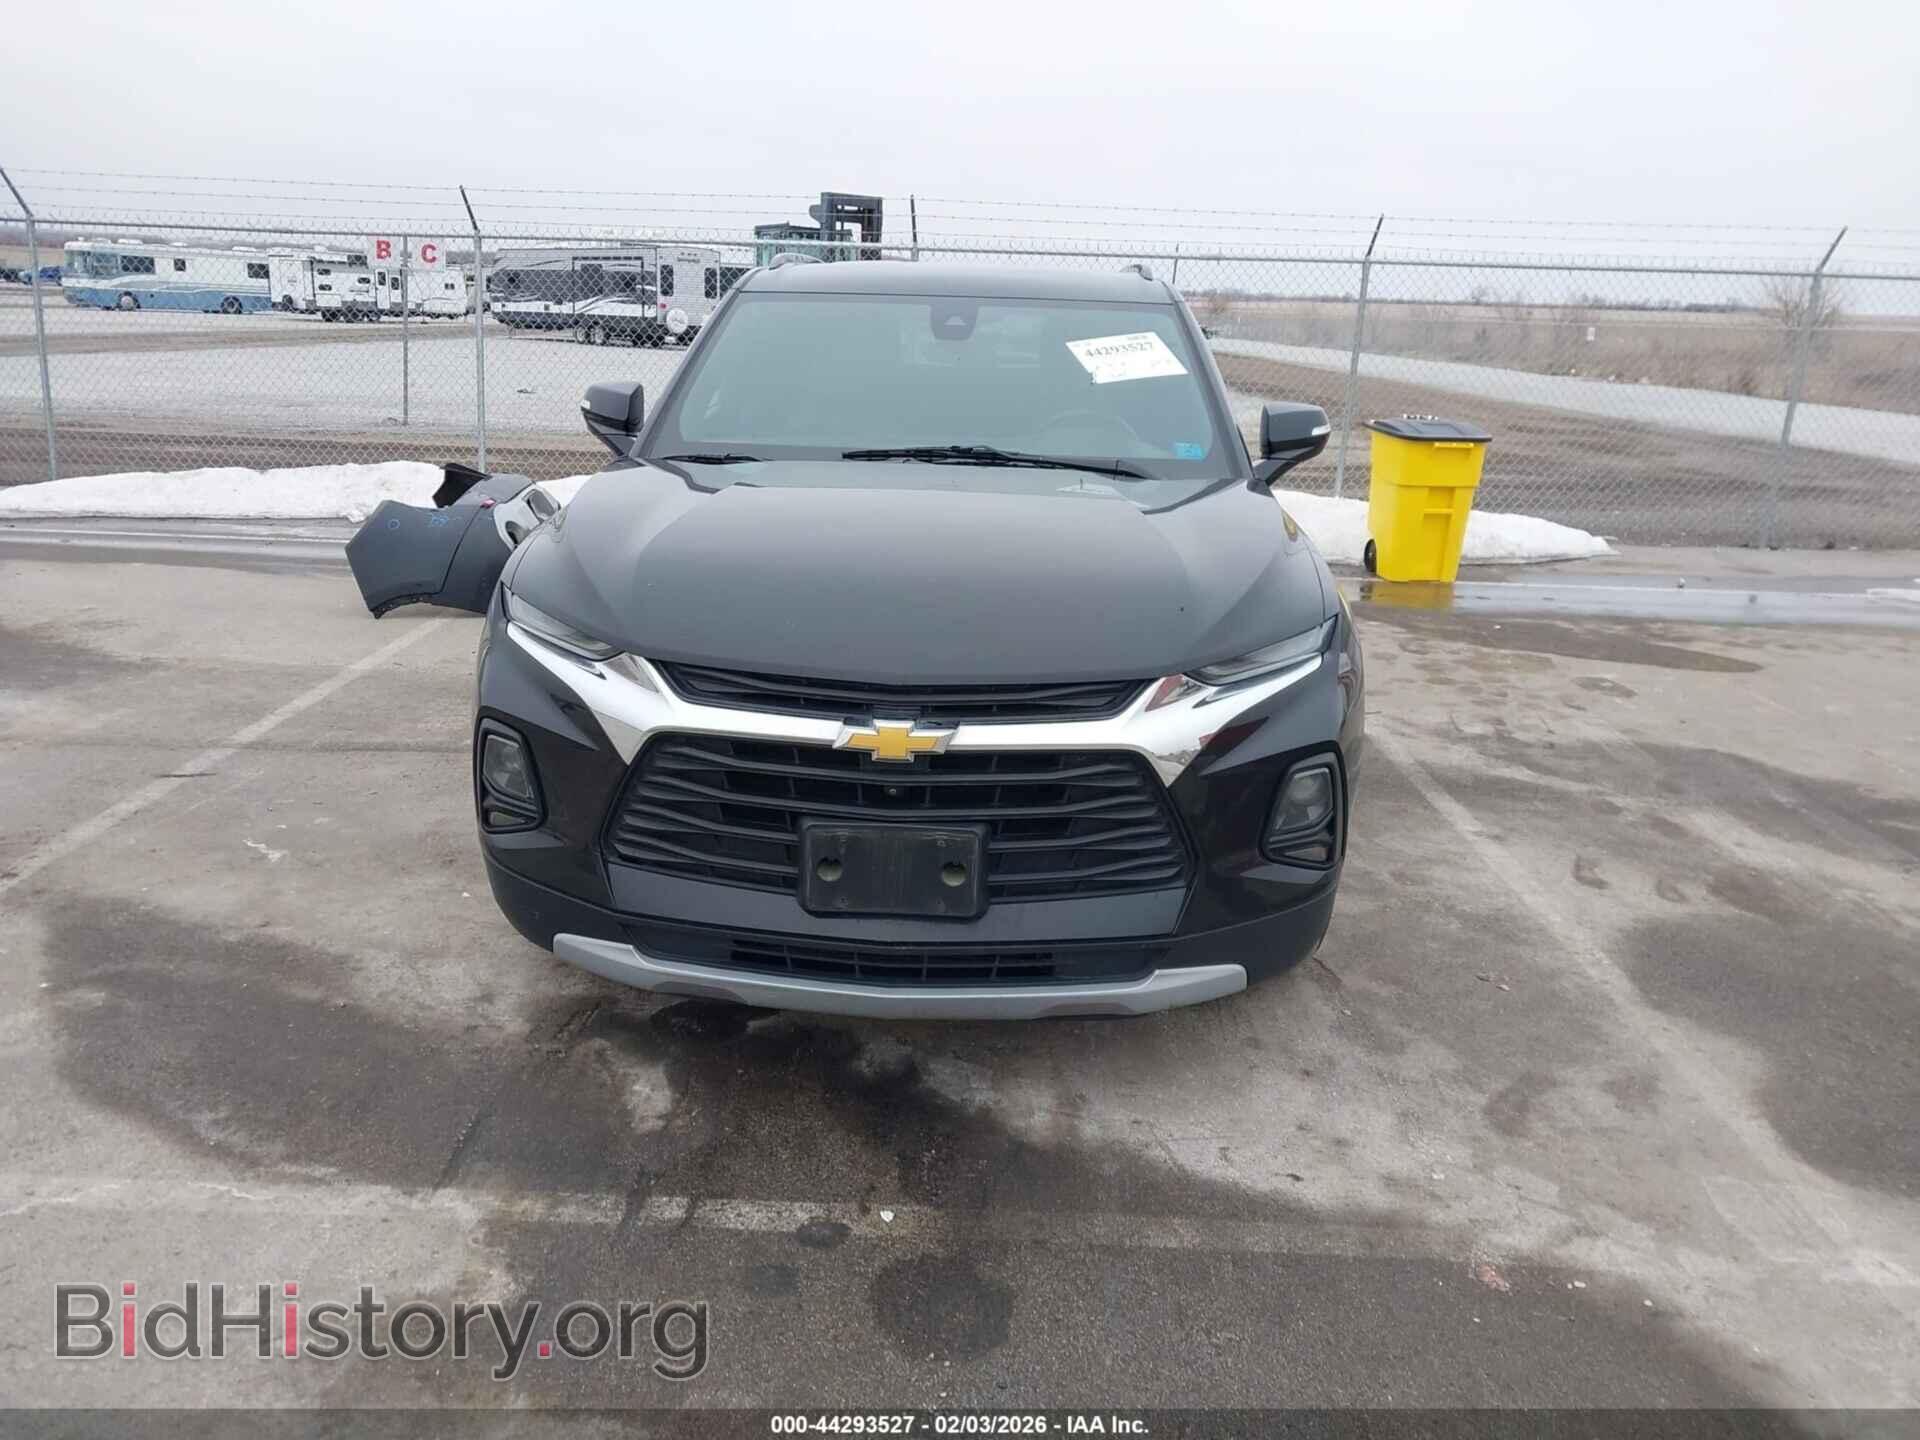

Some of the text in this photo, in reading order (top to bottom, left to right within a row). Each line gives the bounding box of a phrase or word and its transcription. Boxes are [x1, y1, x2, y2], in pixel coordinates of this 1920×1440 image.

[376, 240, 391, 259] B
[421, 244, 437, 263] C
[1083, 341, 1154, 358] 44293527
